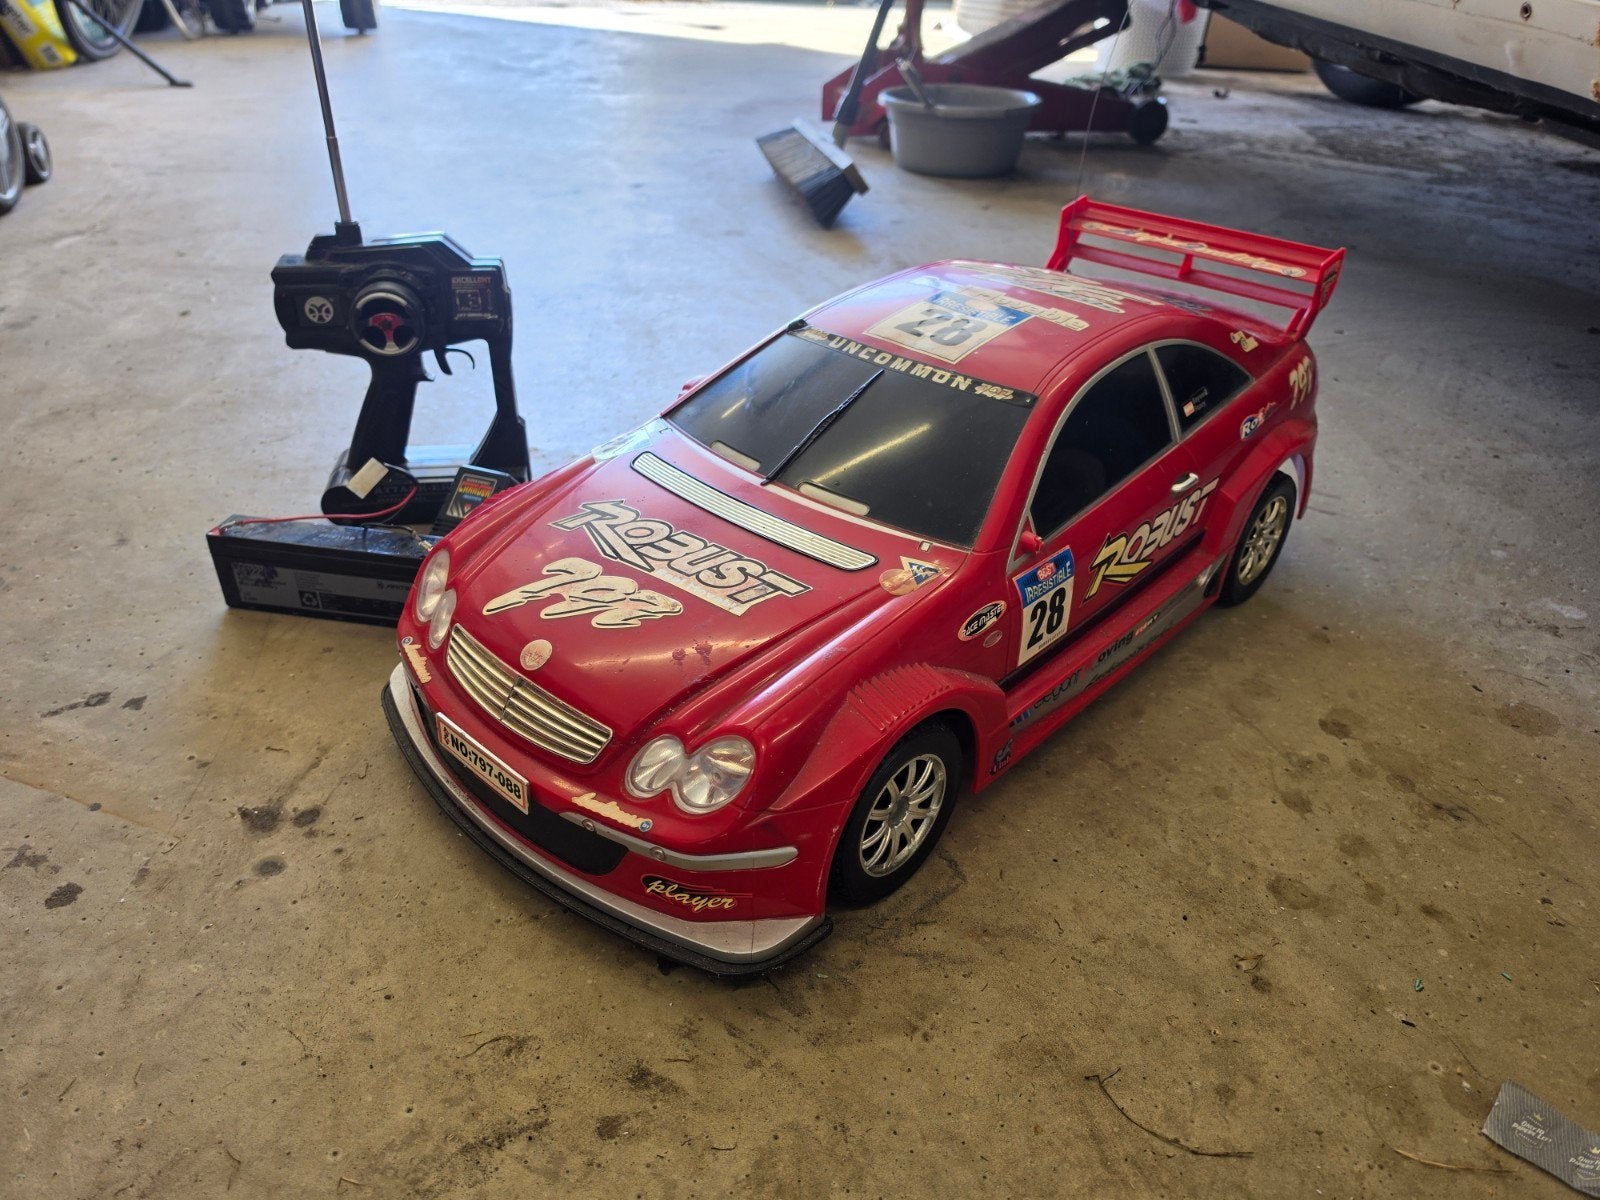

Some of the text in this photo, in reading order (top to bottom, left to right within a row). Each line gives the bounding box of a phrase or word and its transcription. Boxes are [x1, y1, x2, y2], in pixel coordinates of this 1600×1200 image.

[894, 307, 989, 347] 28
[828, 336, 972, 391] UNCOMMON
[1080, 478, 1219, 608] ROBUST
[1027, 587, 1067, 650] 28
[645, 880, 735, 911] player
